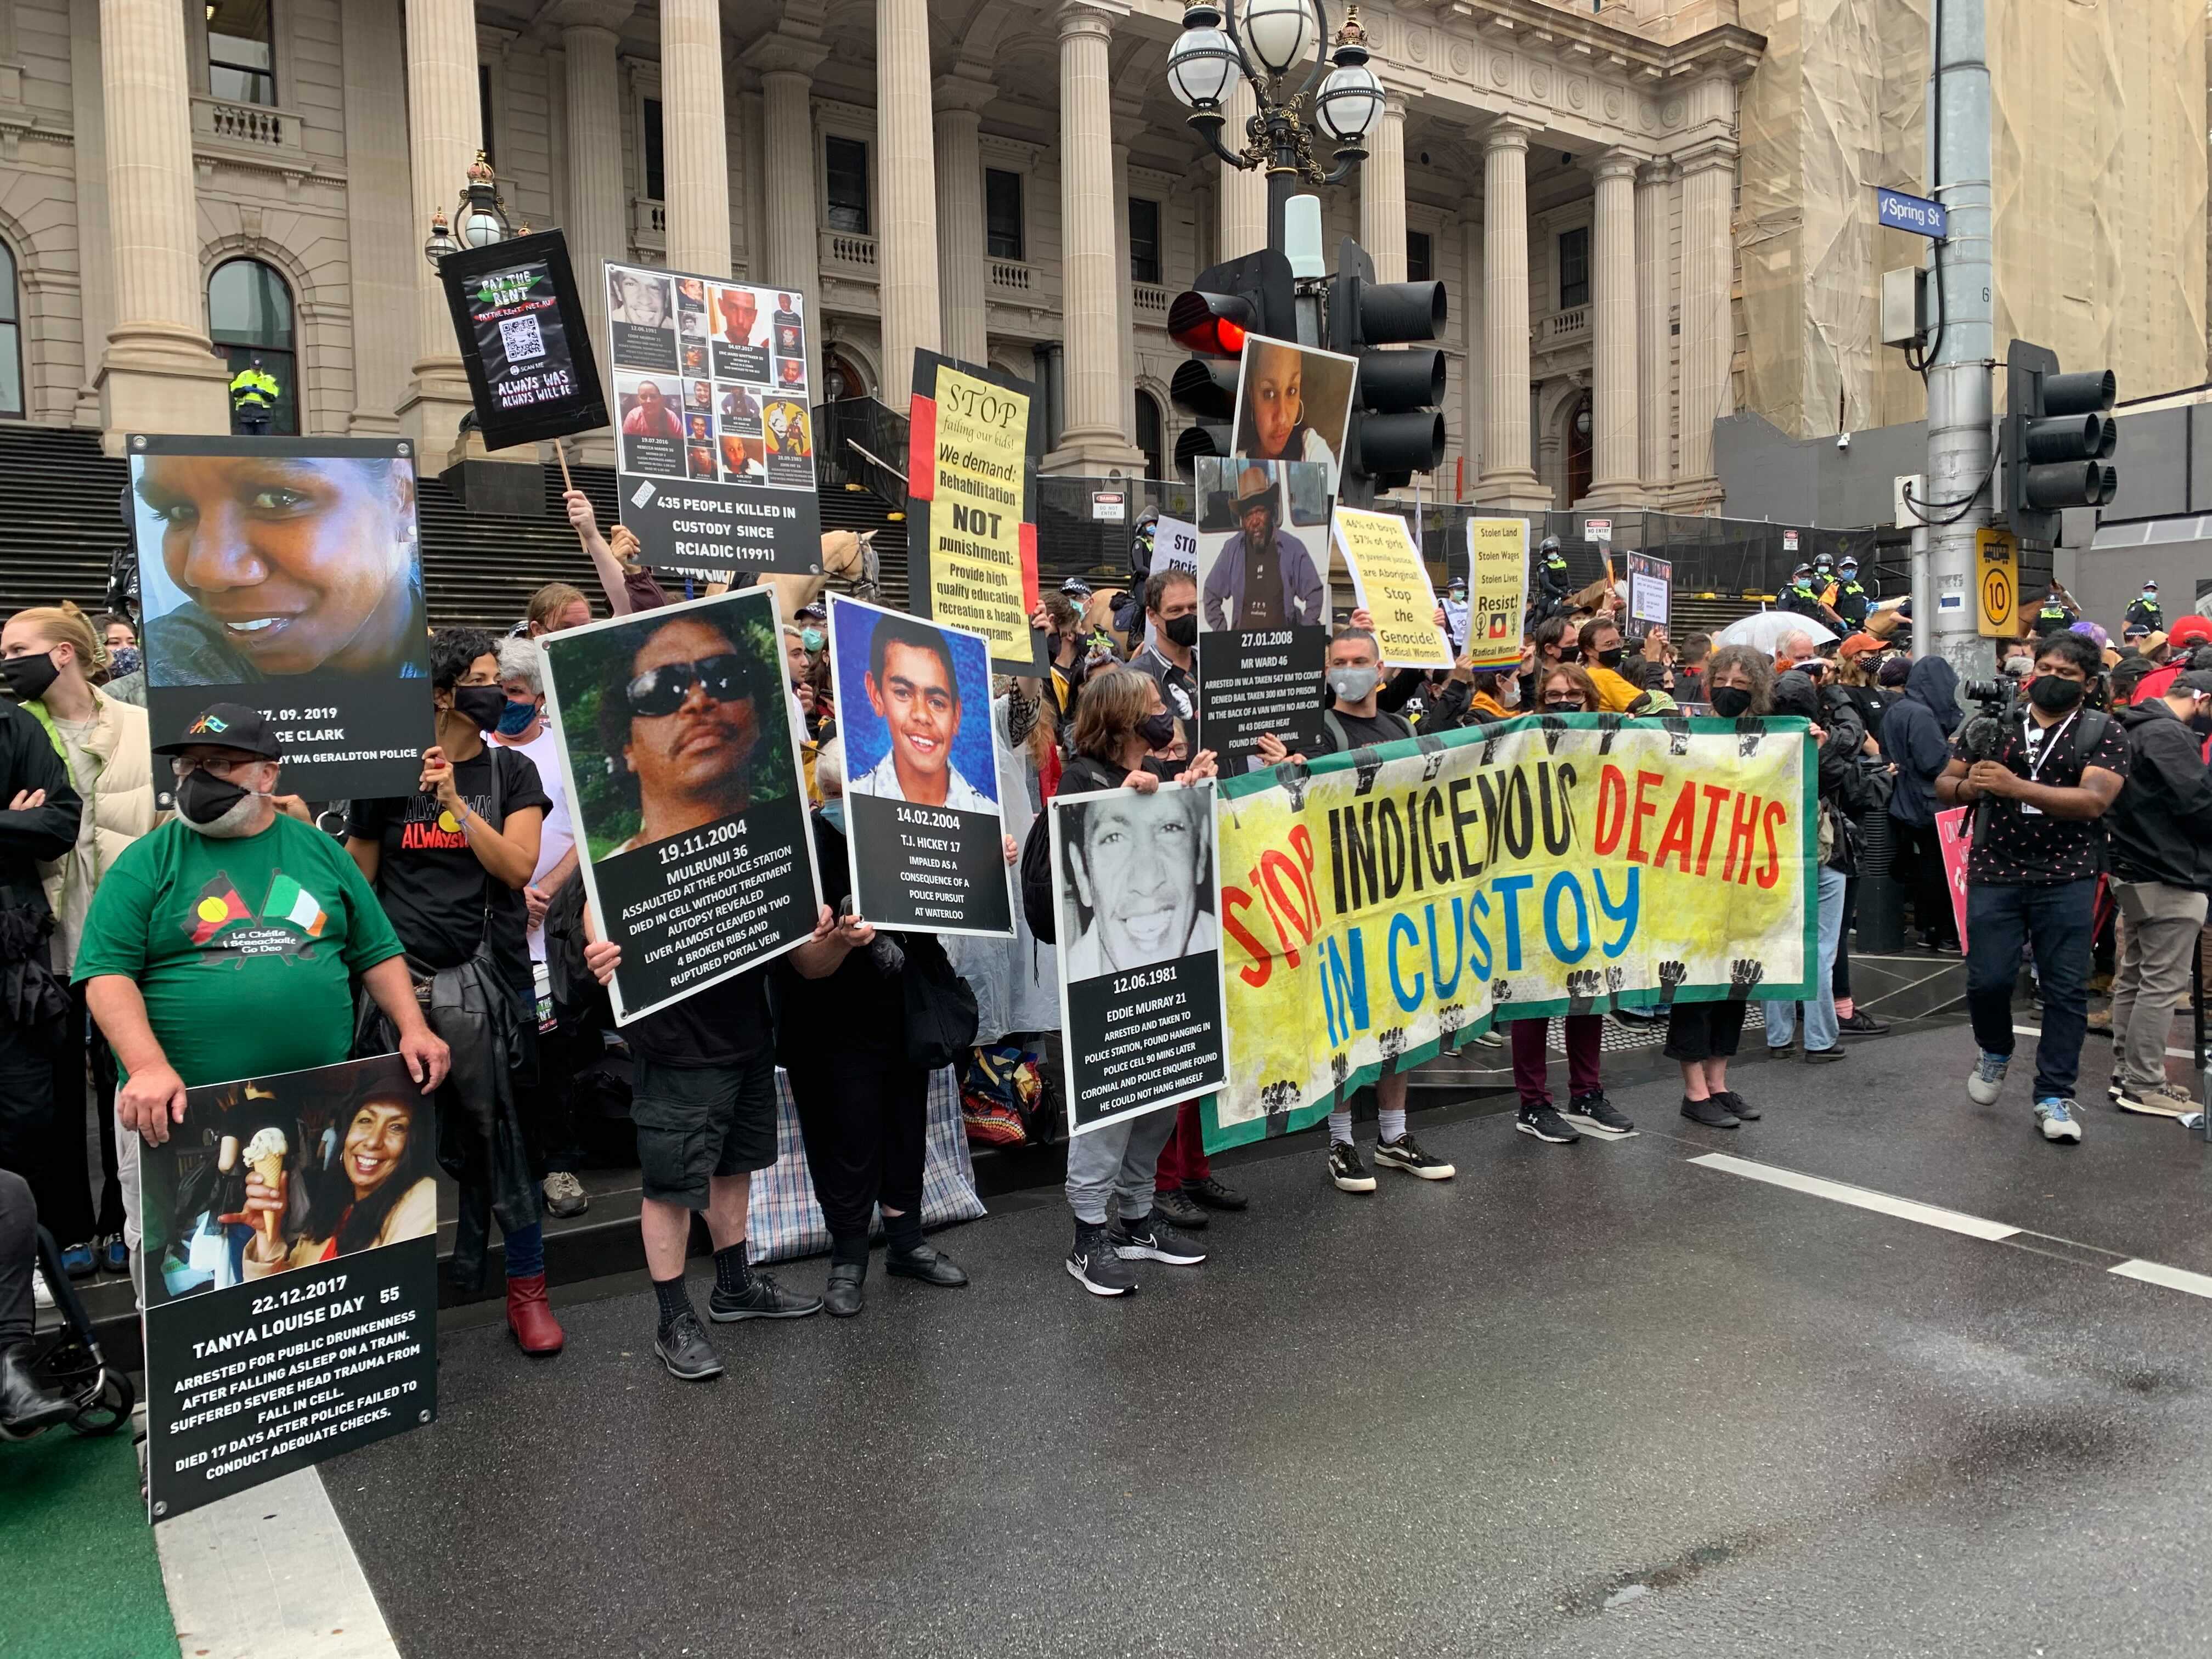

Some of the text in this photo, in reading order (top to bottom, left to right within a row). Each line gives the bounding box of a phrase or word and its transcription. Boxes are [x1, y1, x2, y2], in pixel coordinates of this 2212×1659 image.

[1889, 198, 1940, 227] Spring St
[482, 271, 531, 292] PAY THE
[494, 287, 528, 306] RENT
[498, 370, 568, 395] ALWAYS WAS
[503, 385, 571, 408] ALWAYS WILL BE
[947, 384, 1017, 428] STOP
[941, 415, 1014, 450] failing our kids!
[940, 442, 1016, 482] We demand:
[940, 470, 1015, 506] Rehabilitation
[657, 496, 795, 518] 435 PEOPLE KILLED IN
[672, 520, 774, 538] CUSTODY SINCE
[953, 503, 1002, 539] NOT
[1378, 523, 1397, 534] boys
[1481, 528, 1517, 537] Stolen Land
[675, 541, 774, 561] RCIADIC (1991)
[939, 536, 1013, 566] punishment:
[1175, 534, 1197, 554] STO
[1386, 539, 1403, 549] girls
[1479, 550, 1520, 562] Stolen Wages
[950, 563, 1008, 586] Provide high
[1481, 574, 1518, 584] Stolen Lives
[937, 582, 1020, 608] quality education,
[1384, 587, 1412, 602] Stop
[1479, 594, 1518, 612] Resist!
[1989, 582, 2005, 611] 10
[939, 601, 1021, 624] recreation & health
[1395, 609, 1414, 622] the
[1241, 630, 1293, 647] 27.01.2008
[1380, 630, 1437, 645] Genocide!
[1240, 655, 1288, 669] MR WARD 46
[1384, 647, 1441, 658] Radical Women
[1472, 645, 1516, 657] Radical Women
[280, 709, 301, 720] 09.
[304, 707, 338, 719] 2019
[297, 729, 345, 741] CLARK
[292, 754, 311, 764] WA
[313, 750, 377, 763] GERALDTON
[380, 748, 417, 759] POLICE
[896, 807, 960, 830] 14.02.2004
[402, 823, 458, 849] ALWAYS
[658, 820, 747, 864] 19.11.2004
[900, 834, 960, 852] T.J. HICKEY 17
[666, 844, 748, 885] MULRUNJI 36
[909, 855, 957, 870] IMPALED AS A
[900, 871, 969, 887] CONSEQUENCE OF A
[1221, 761, 1787, 988] STOP INDIGENOUS DEATHS
[909, 889, 964, 903] POLICE PURSUIT
[915, 907, 963, 919] AT WATERLOO
[1387, 867, 1640, 1013] CUSTOY
[670, 932, 780, 987] RUPTURED PORTAL VEIN
[1113, 966, 1177, 994] 12.06.1981
[1107, 992, 1186, 1022] EDDIE MURRAY 21
[252, 1275, 347, 1314] 22.12.2017
[192, 1286, 399, 1358] TANYA LOUISE DAY 55
[174, 1310, 415, 1393] ARRESTED FOR PUBLIC DRUNKENNESS
[182, 1331, 409, 1410] AFTER FALLING ASLEEP ON A TRAIN.
[170, 1344, 420, 1434] SUFFERED SEVERE HEAD TRAUMA FROM
[258, 1390, 344, 1424] FALL IN CELL.
[175, 1380, 416, 1472] DIED 17 DAYS AFTER POLICE FAILED TO
[206, 1408, 391, 1480] CONDUCT ADEQUATE CHECKS.
